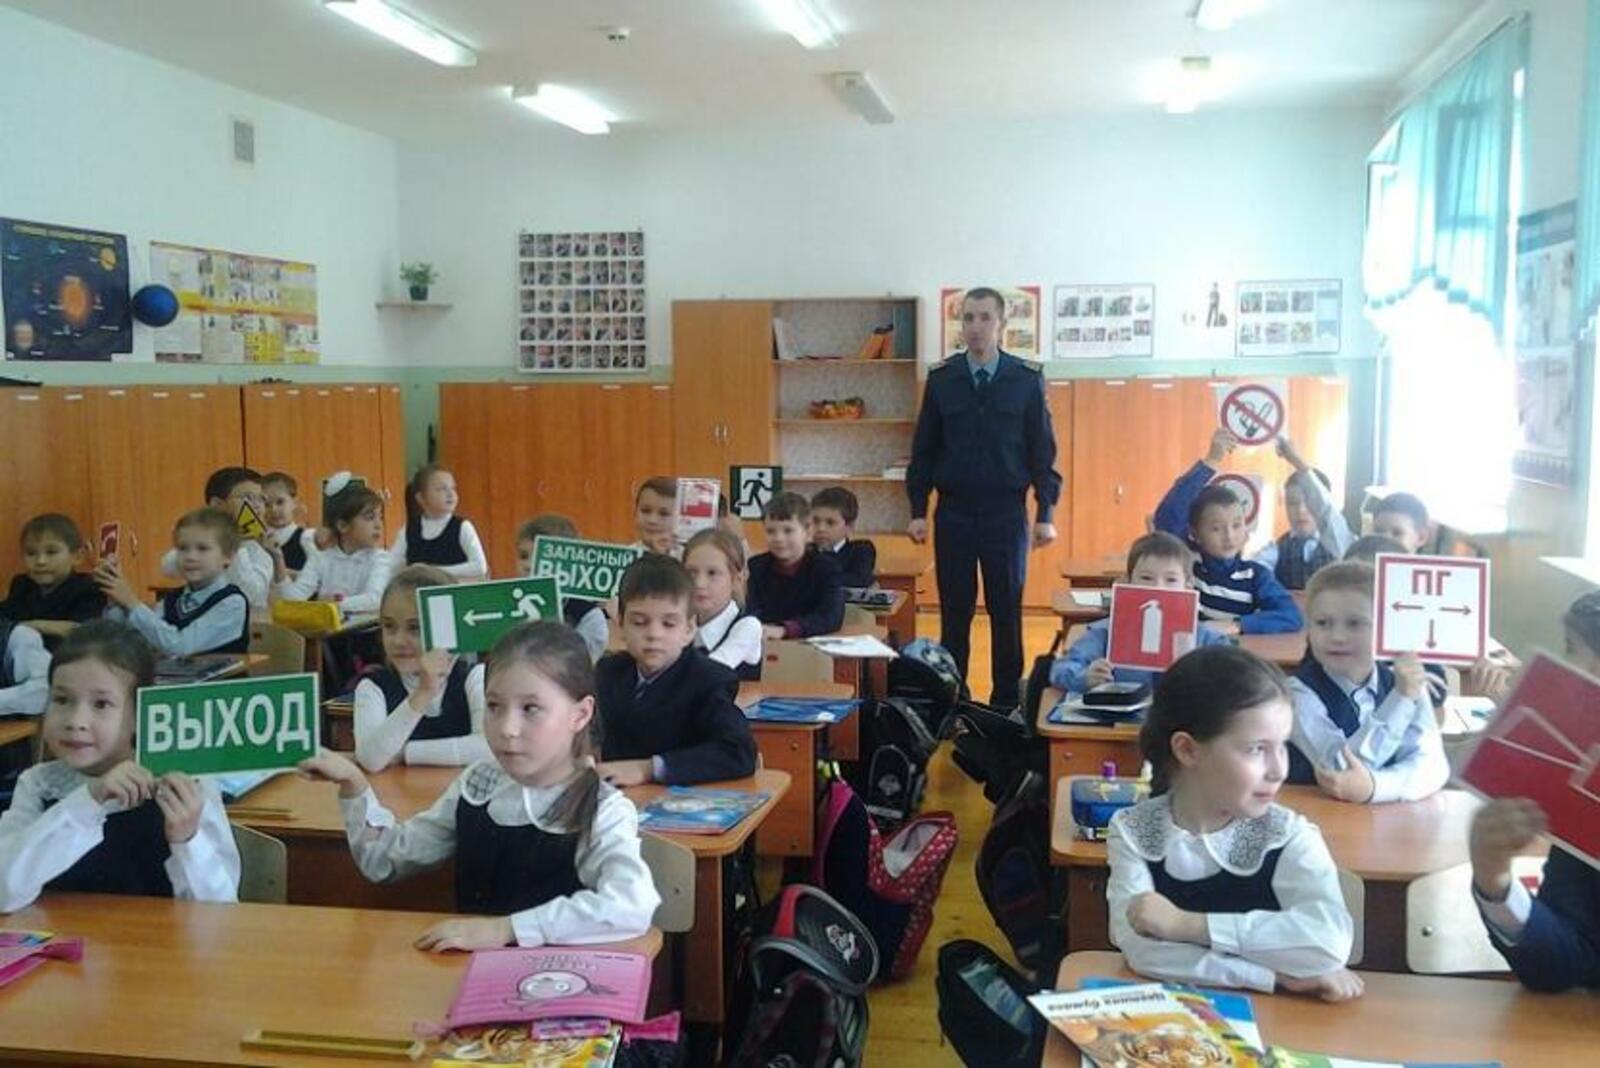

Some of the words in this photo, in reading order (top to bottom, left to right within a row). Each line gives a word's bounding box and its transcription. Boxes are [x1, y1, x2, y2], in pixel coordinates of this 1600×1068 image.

[543, 543, 634, 567] ЗАПАСНЫЙ
[1412, 569, 1451, 596] ПГ
[147, 692, 310, 753] ВЫХОД
